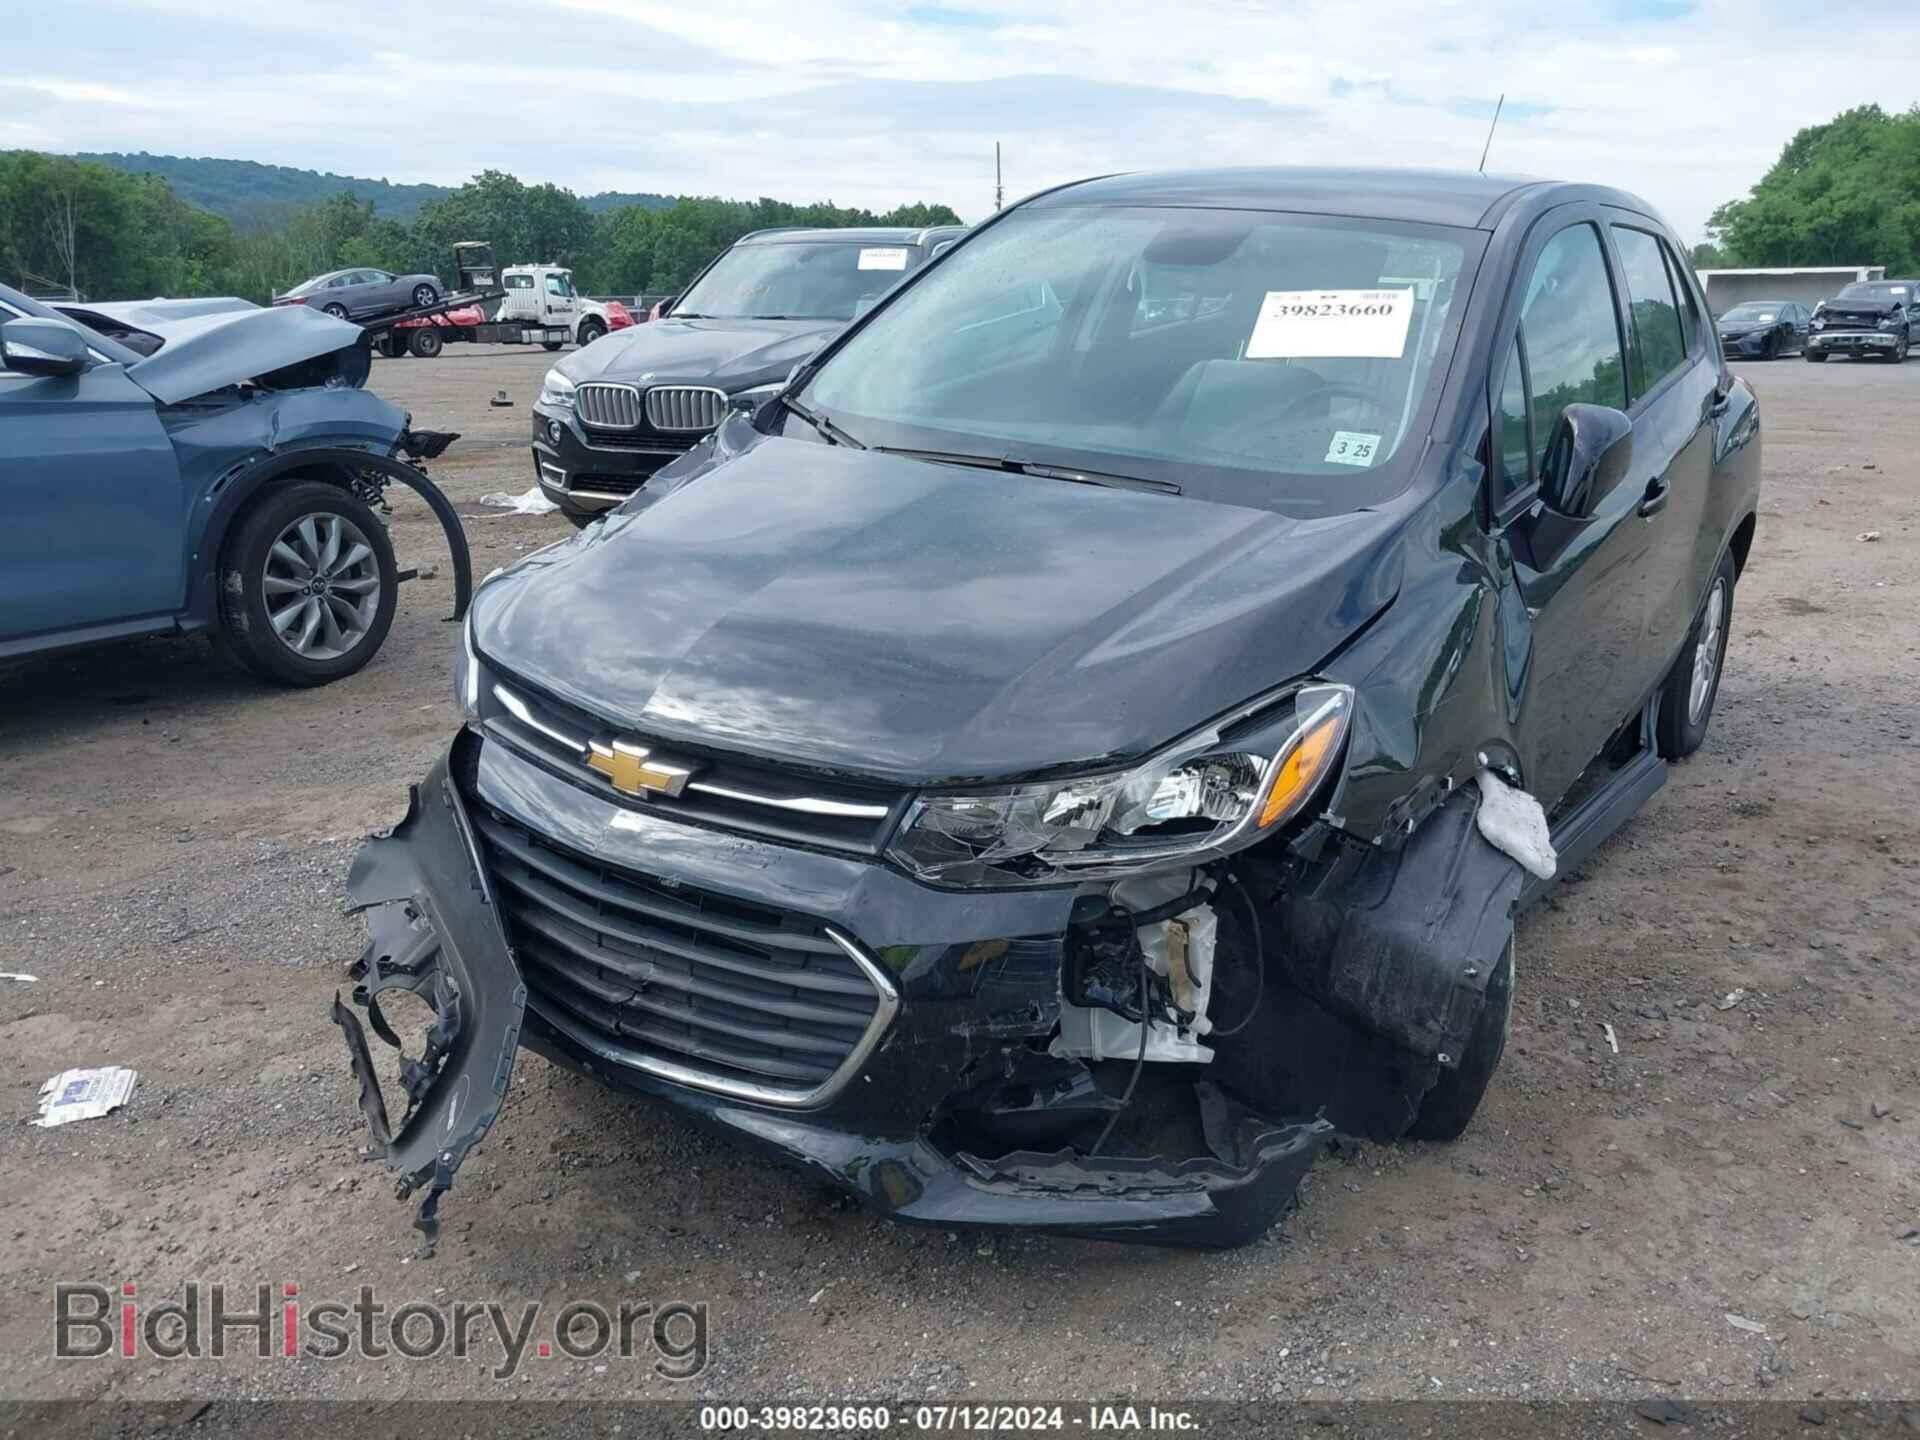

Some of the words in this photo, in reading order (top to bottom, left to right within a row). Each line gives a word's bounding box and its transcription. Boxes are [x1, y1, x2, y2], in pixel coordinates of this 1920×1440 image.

[1274, 304, 1393, 317] 39823660
[1337, 442, 1349, 455] 3
[1353, 444, 1372, 458] 25
